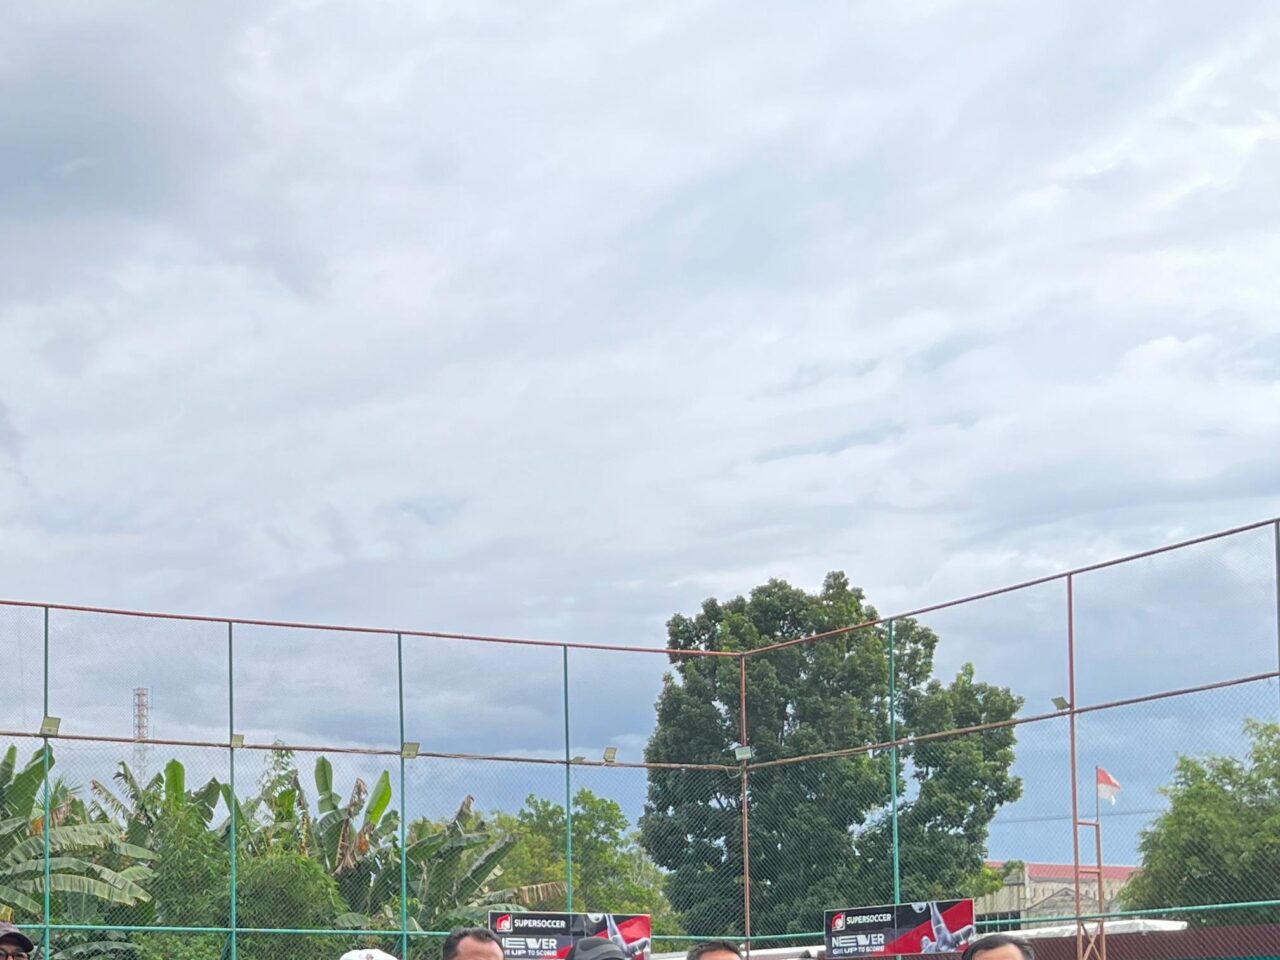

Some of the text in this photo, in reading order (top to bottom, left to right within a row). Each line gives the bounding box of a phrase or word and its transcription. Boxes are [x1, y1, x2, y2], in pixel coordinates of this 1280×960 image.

[514, 919, 566, 928] SUPERSOCCER
[846, 913, 892, 925] SUPERSOCCER
[832, 934, 885, 948] NEVER
